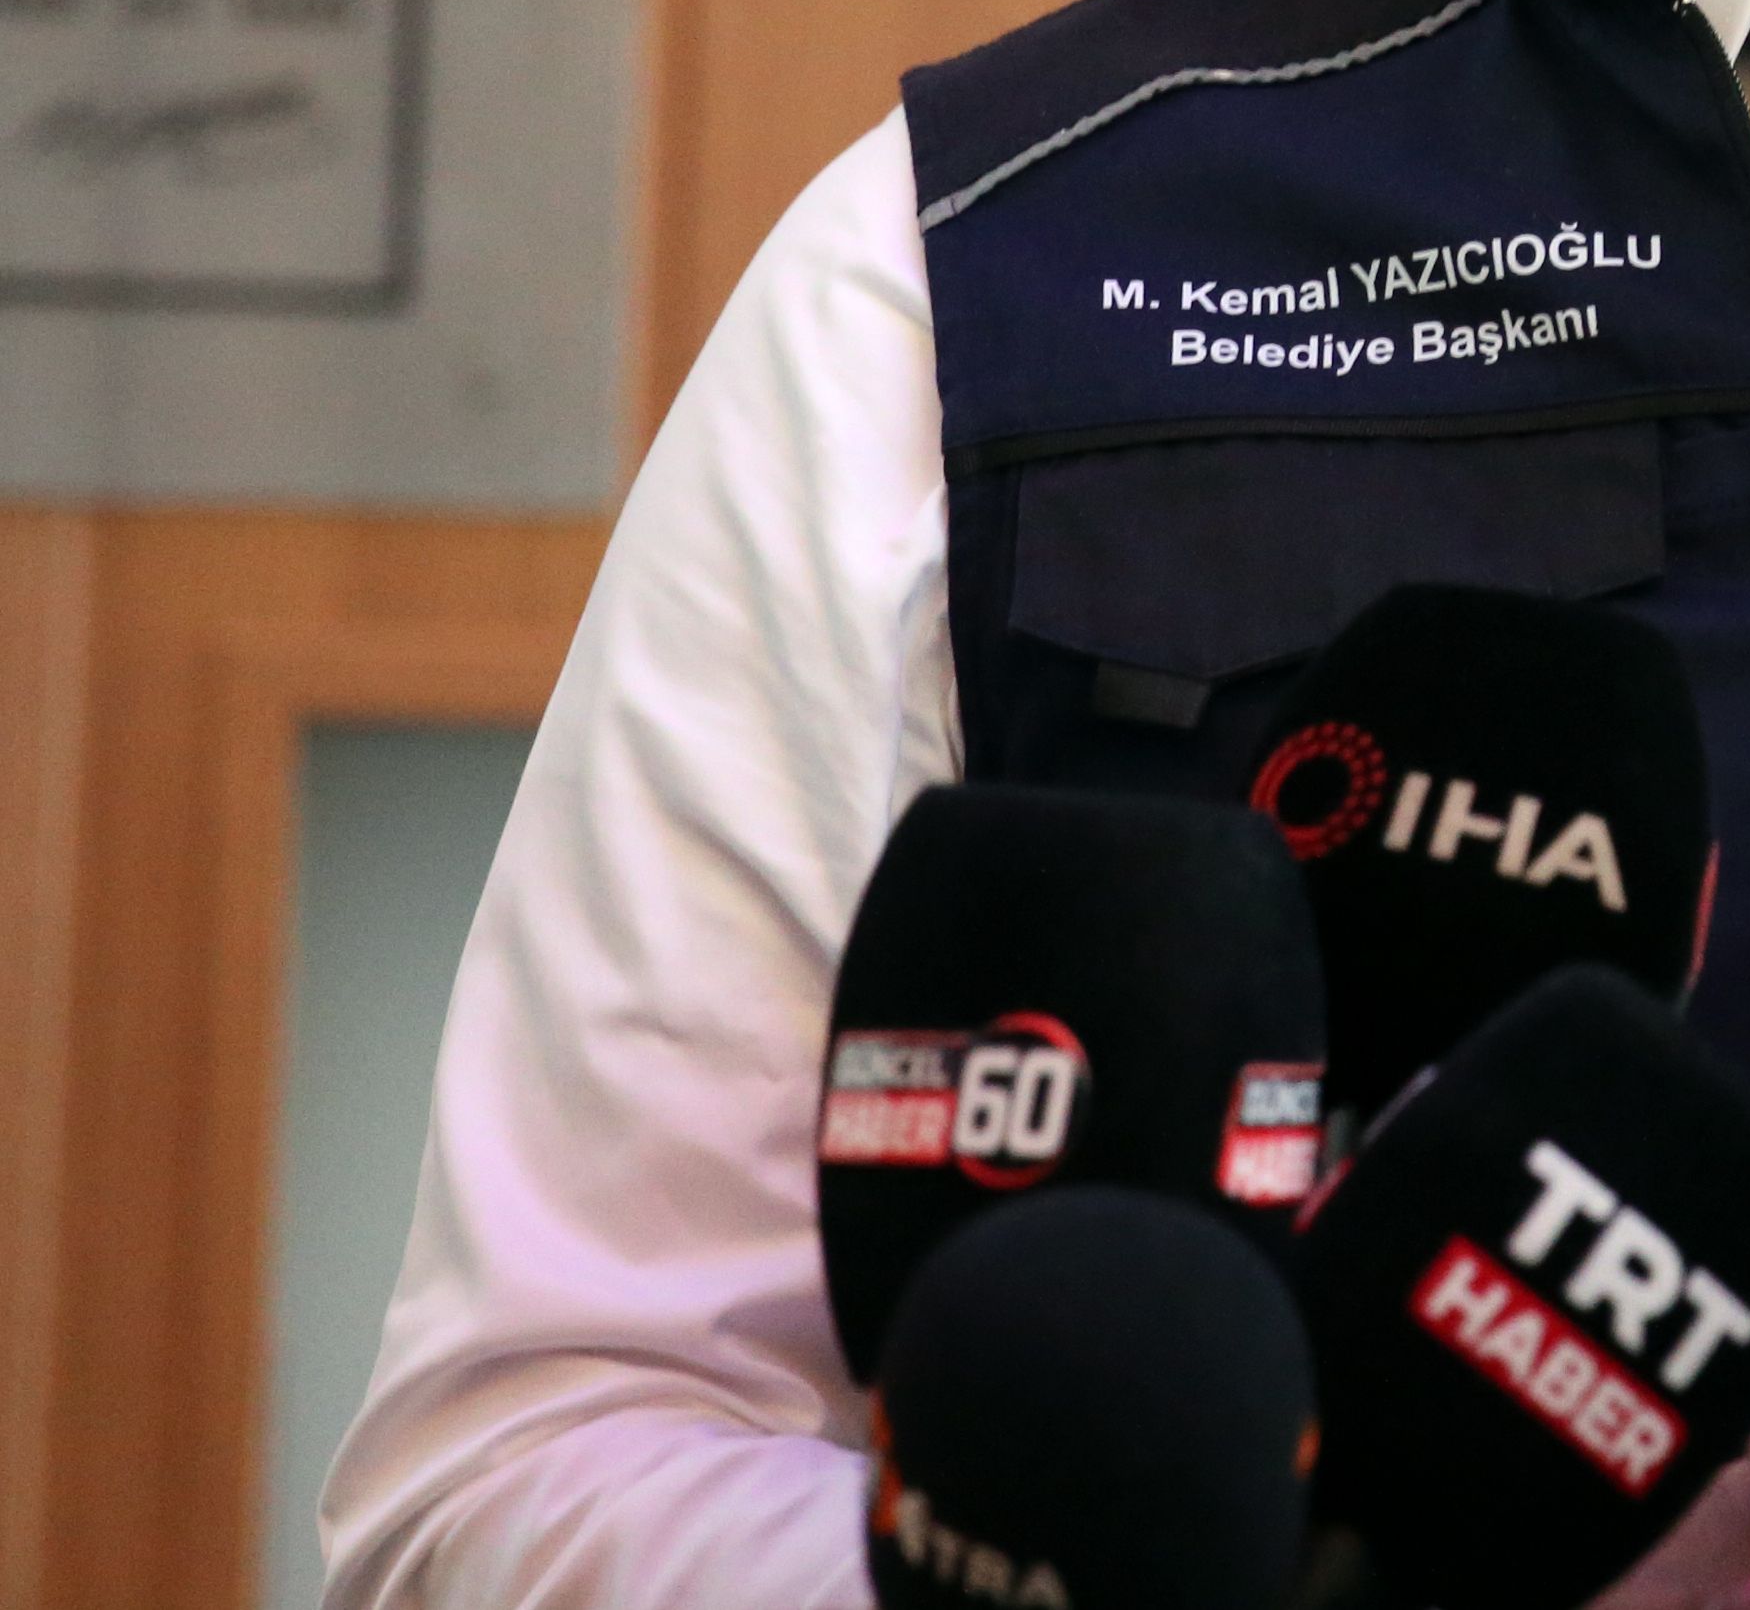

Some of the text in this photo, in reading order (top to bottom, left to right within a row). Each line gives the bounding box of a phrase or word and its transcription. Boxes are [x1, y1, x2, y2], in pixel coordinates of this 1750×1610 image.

[1102, 221, 1662, 316] M. Kemal YAZICIOĞLU
[1171, 304, 1599, 377] Belediye Başkanı
[1382, 770, 1628, 913] IHA
[952, 1043, 1077, 1158] 60
[1424, 1258, 1676, 1486] HABER
